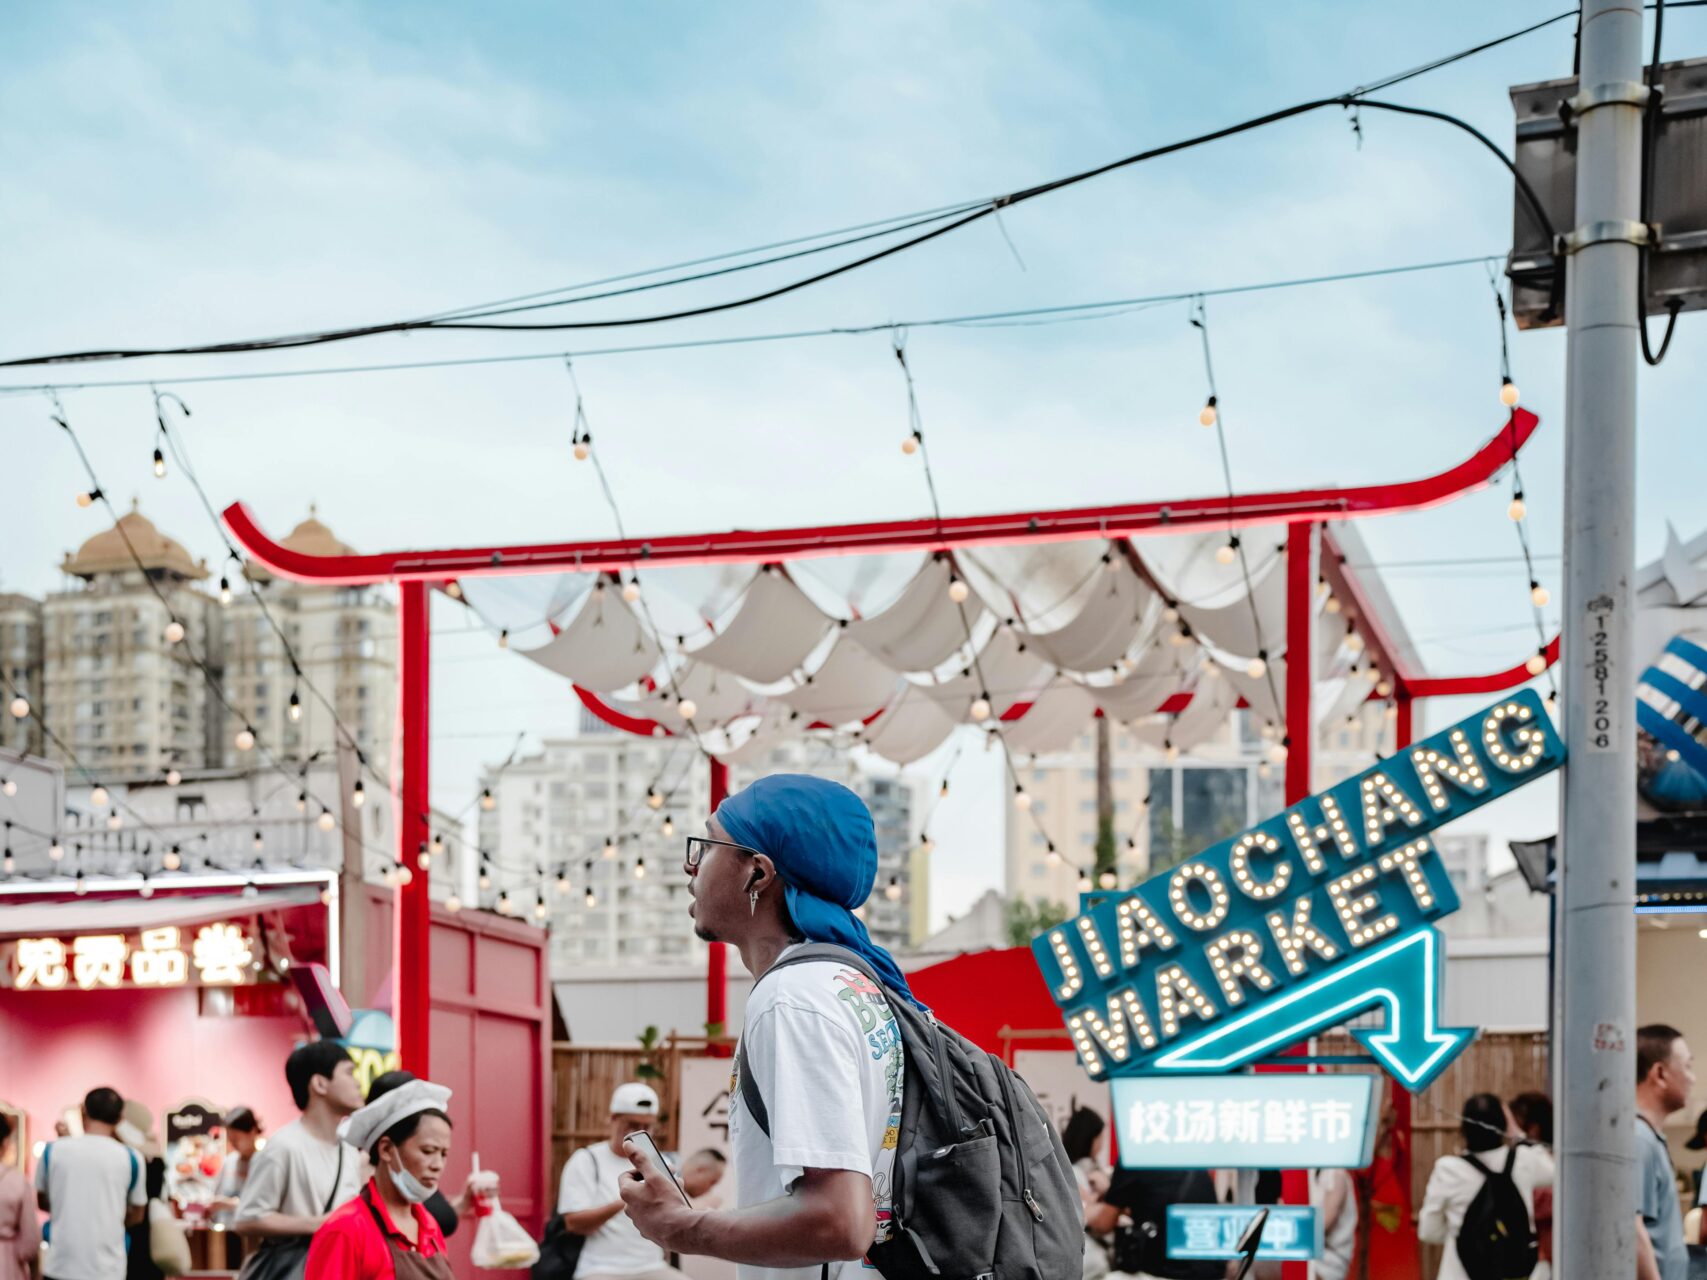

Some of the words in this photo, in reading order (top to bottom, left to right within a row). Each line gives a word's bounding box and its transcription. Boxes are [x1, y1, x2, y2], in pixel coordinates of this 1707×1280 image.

[1047, 701, 1545, 1001] JIAOCHANG
[1066, 835, 1431, 1075] MARKET
[1128, 1098, 1353, 1144] 校场新鲜市
